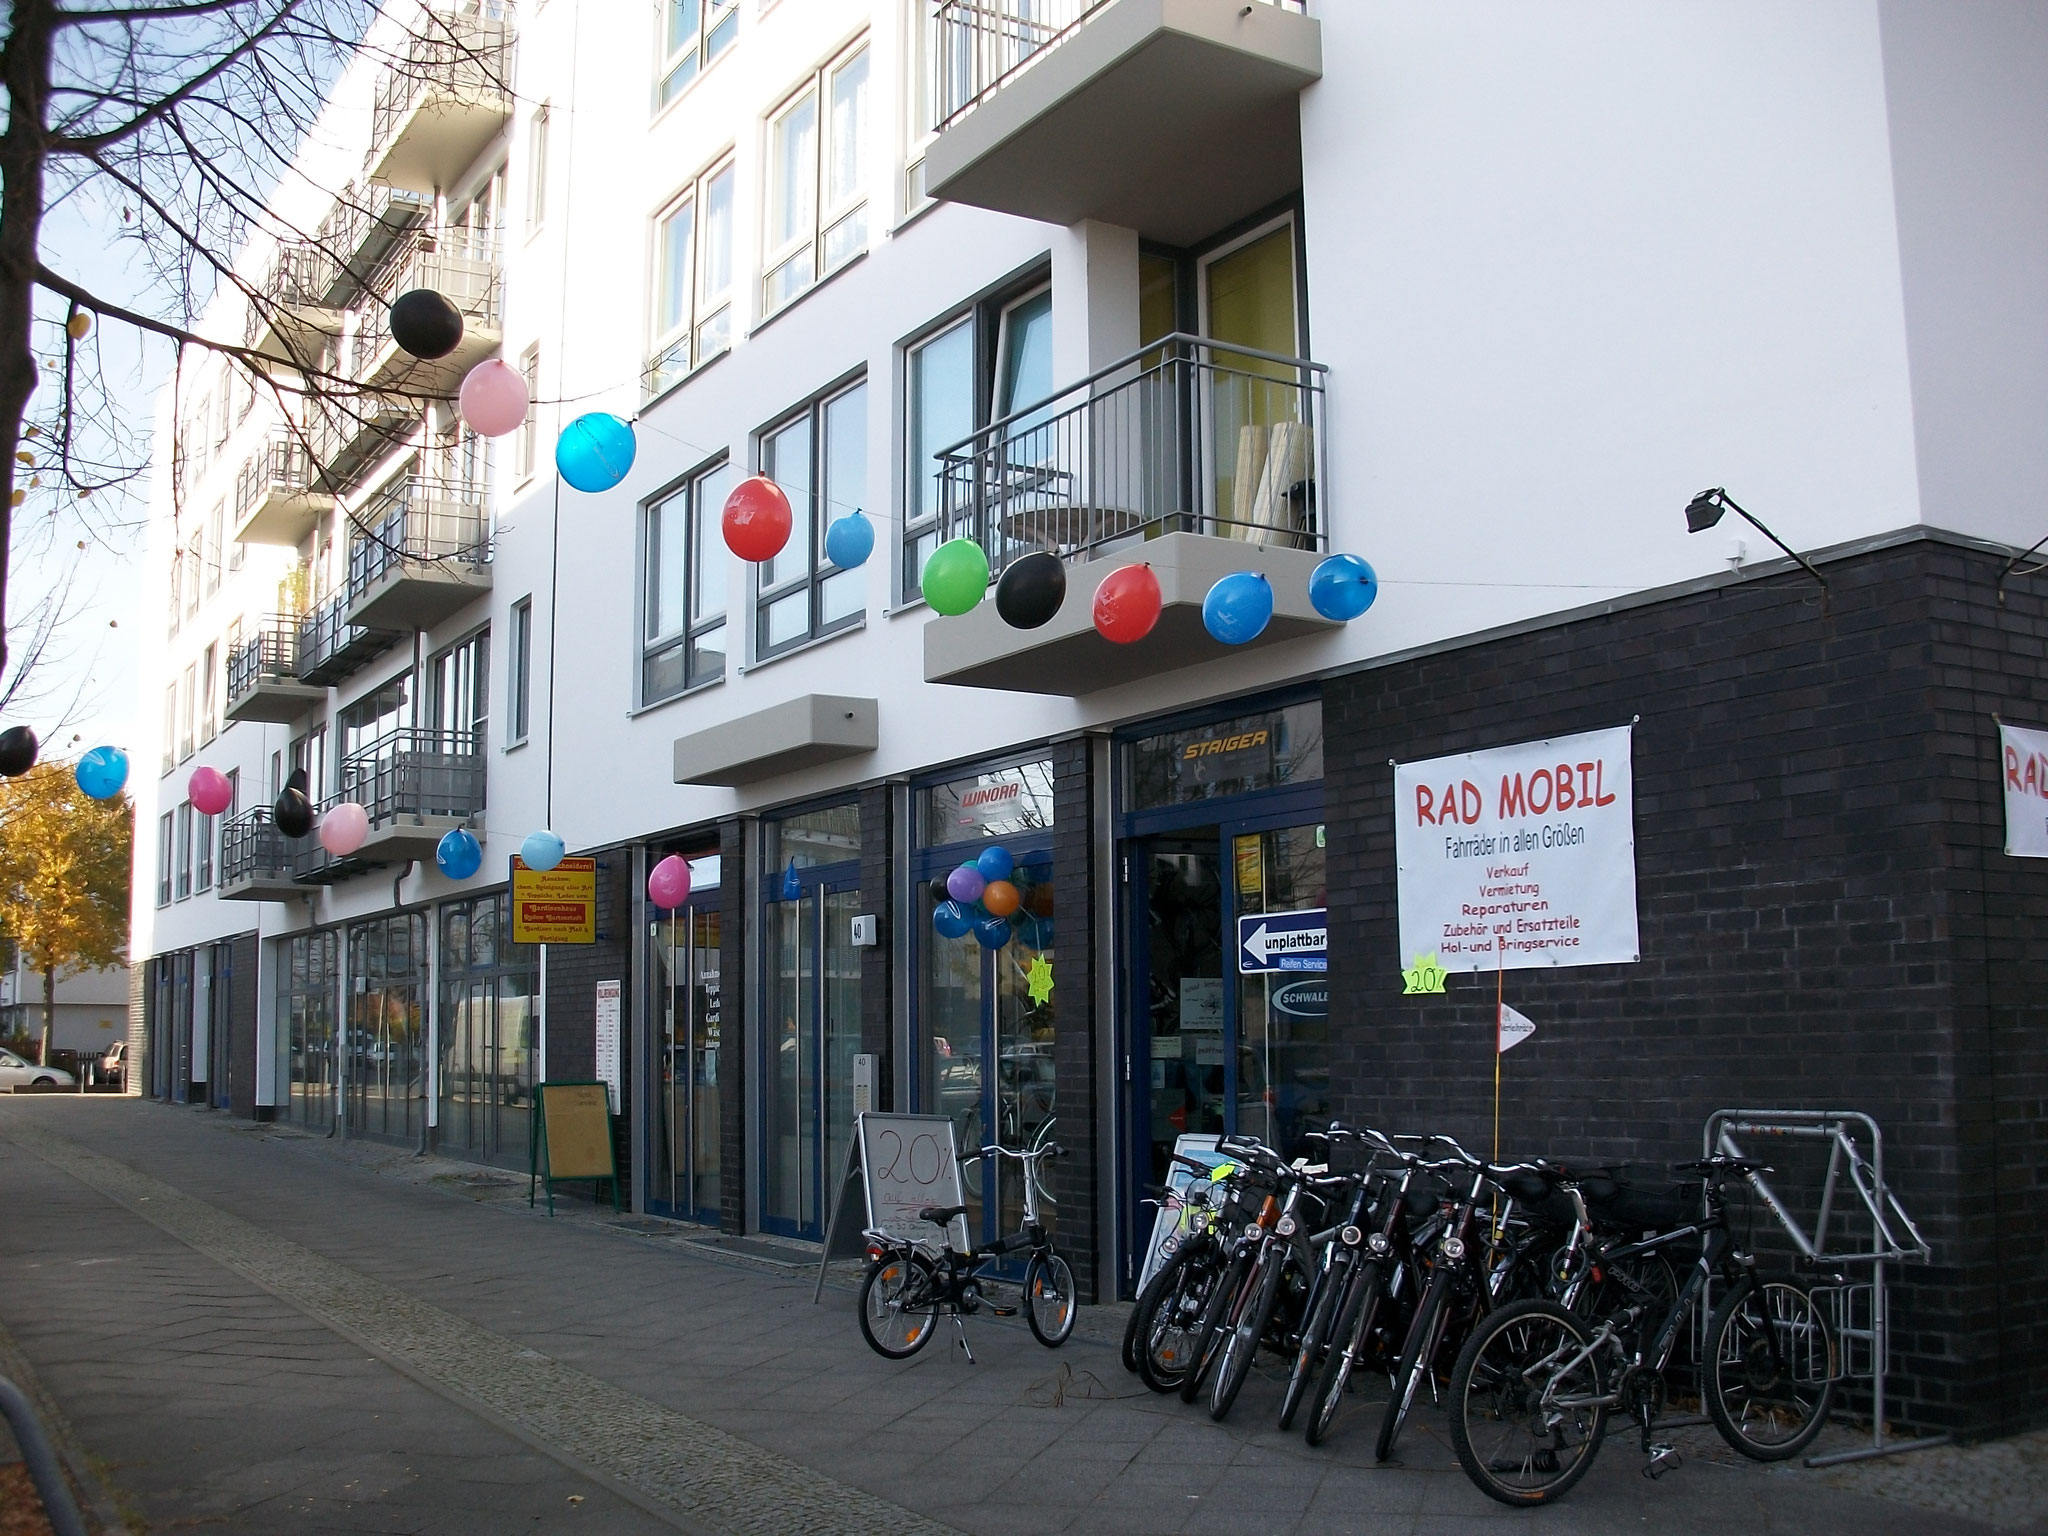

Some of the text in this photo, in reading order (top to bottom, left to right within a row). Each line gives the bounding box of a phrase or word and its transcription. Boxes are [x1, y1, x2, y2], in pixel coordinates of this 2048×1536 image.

[1183, 730, 1268, 760] STAIGER
[962, 783, 1019, 808] WINORA
[1415, 759, 1616, 827] RAD MOBIL
[1445, 822, 1585, 859] Fahrräder in allen Größen
[1486, 863, 1530, 879] Verkauf
[1479, 883, 1540, 898] Vermietung
[1462, 900, 1549, 918] Reparaturen
[854, 923, 862, 940] 40
[1443, 916, 1580, 938] Zubehör und Ersatzteile
[1265, 933, 1325, 951] unplattbar
[1499, 935, 1580, 953] Bringservice
[1281, 959, 1302, 969] Reifen
[1411, 967, 1443, 992] 20%
[858, 1057, 866, 1066] 40
[877, 1130, 954, 1185] 20%
